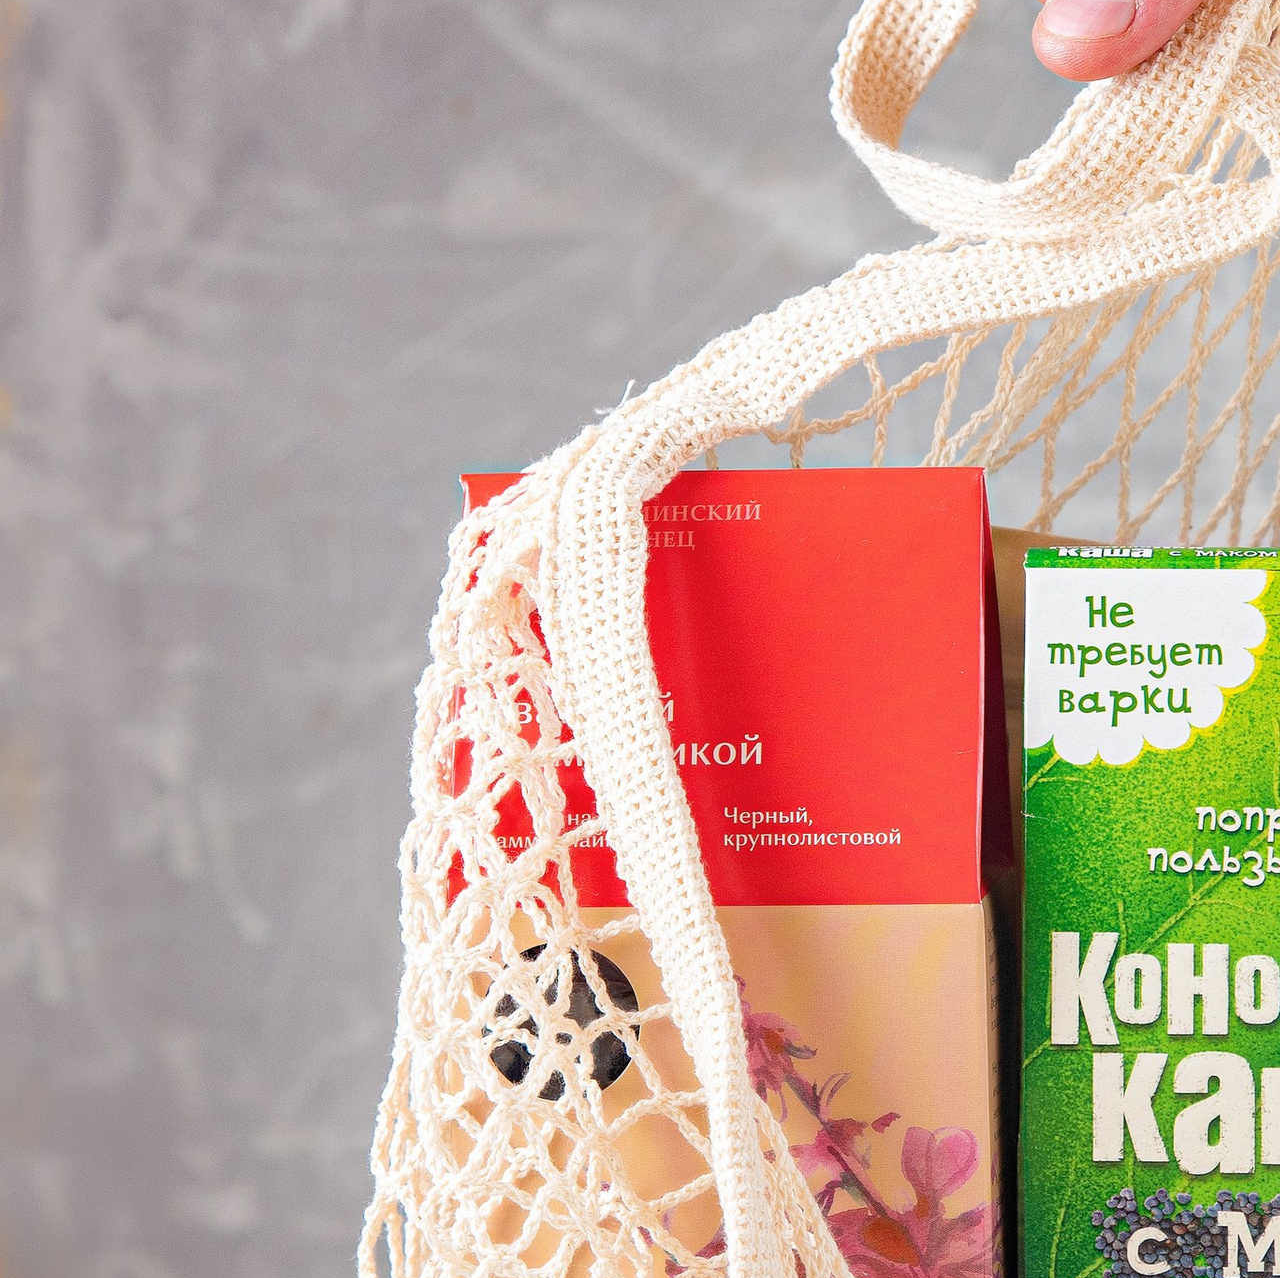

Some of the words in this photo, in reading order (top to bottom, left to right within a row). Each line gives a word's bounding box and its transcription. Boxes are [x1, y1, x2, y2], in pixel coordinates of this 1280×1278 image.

[644, 499, 762, 522] ИНСКИЙ
[1086, 595, 1135, 628] Не
[1048, 641, 1224, 668] требует
[1058, 685, 1192, 726] варки
[723, 806, 813, 828] Черный,
[723, 828, 902, 851] крупнолистовой
